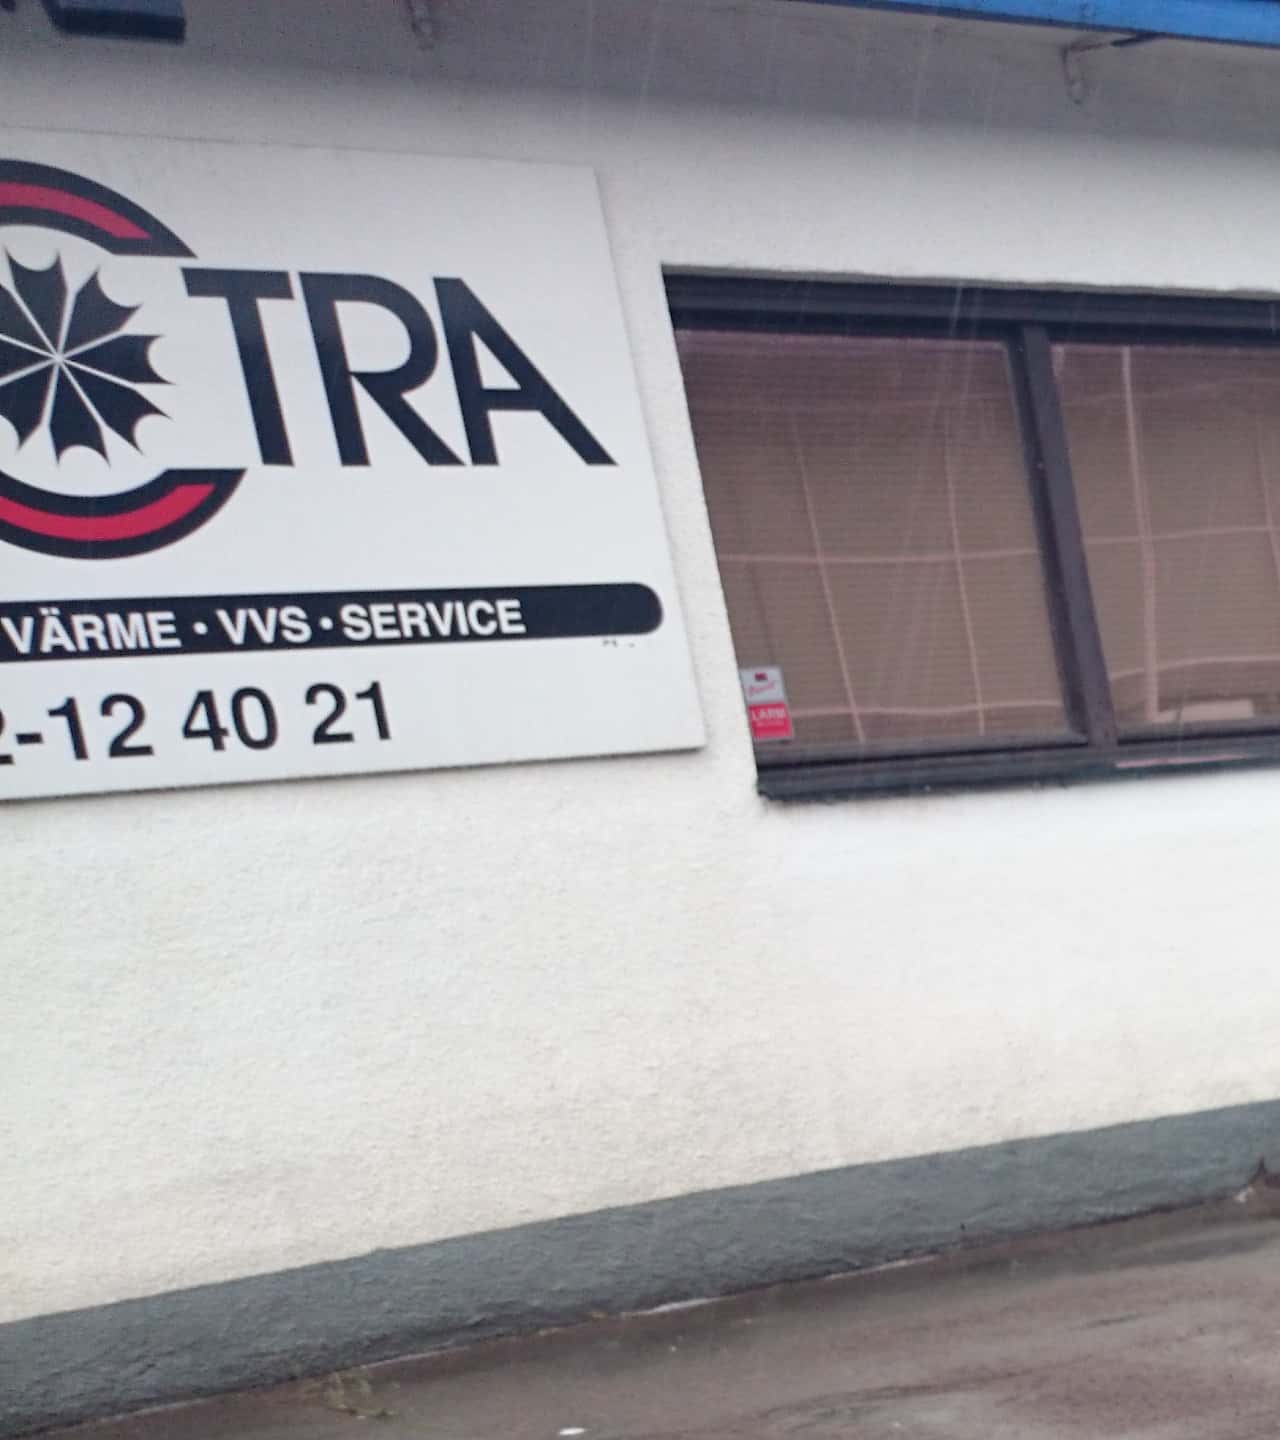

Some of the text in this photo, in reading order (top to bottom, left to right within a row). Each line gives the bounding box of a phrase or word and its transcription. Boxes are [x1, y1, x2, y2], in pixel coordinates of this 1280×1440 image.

[1, 598, 526, 654] VÄRME VVS SERVICE
[181, 686, 279, 752] 40
[304, 680, 394, 744] 21
